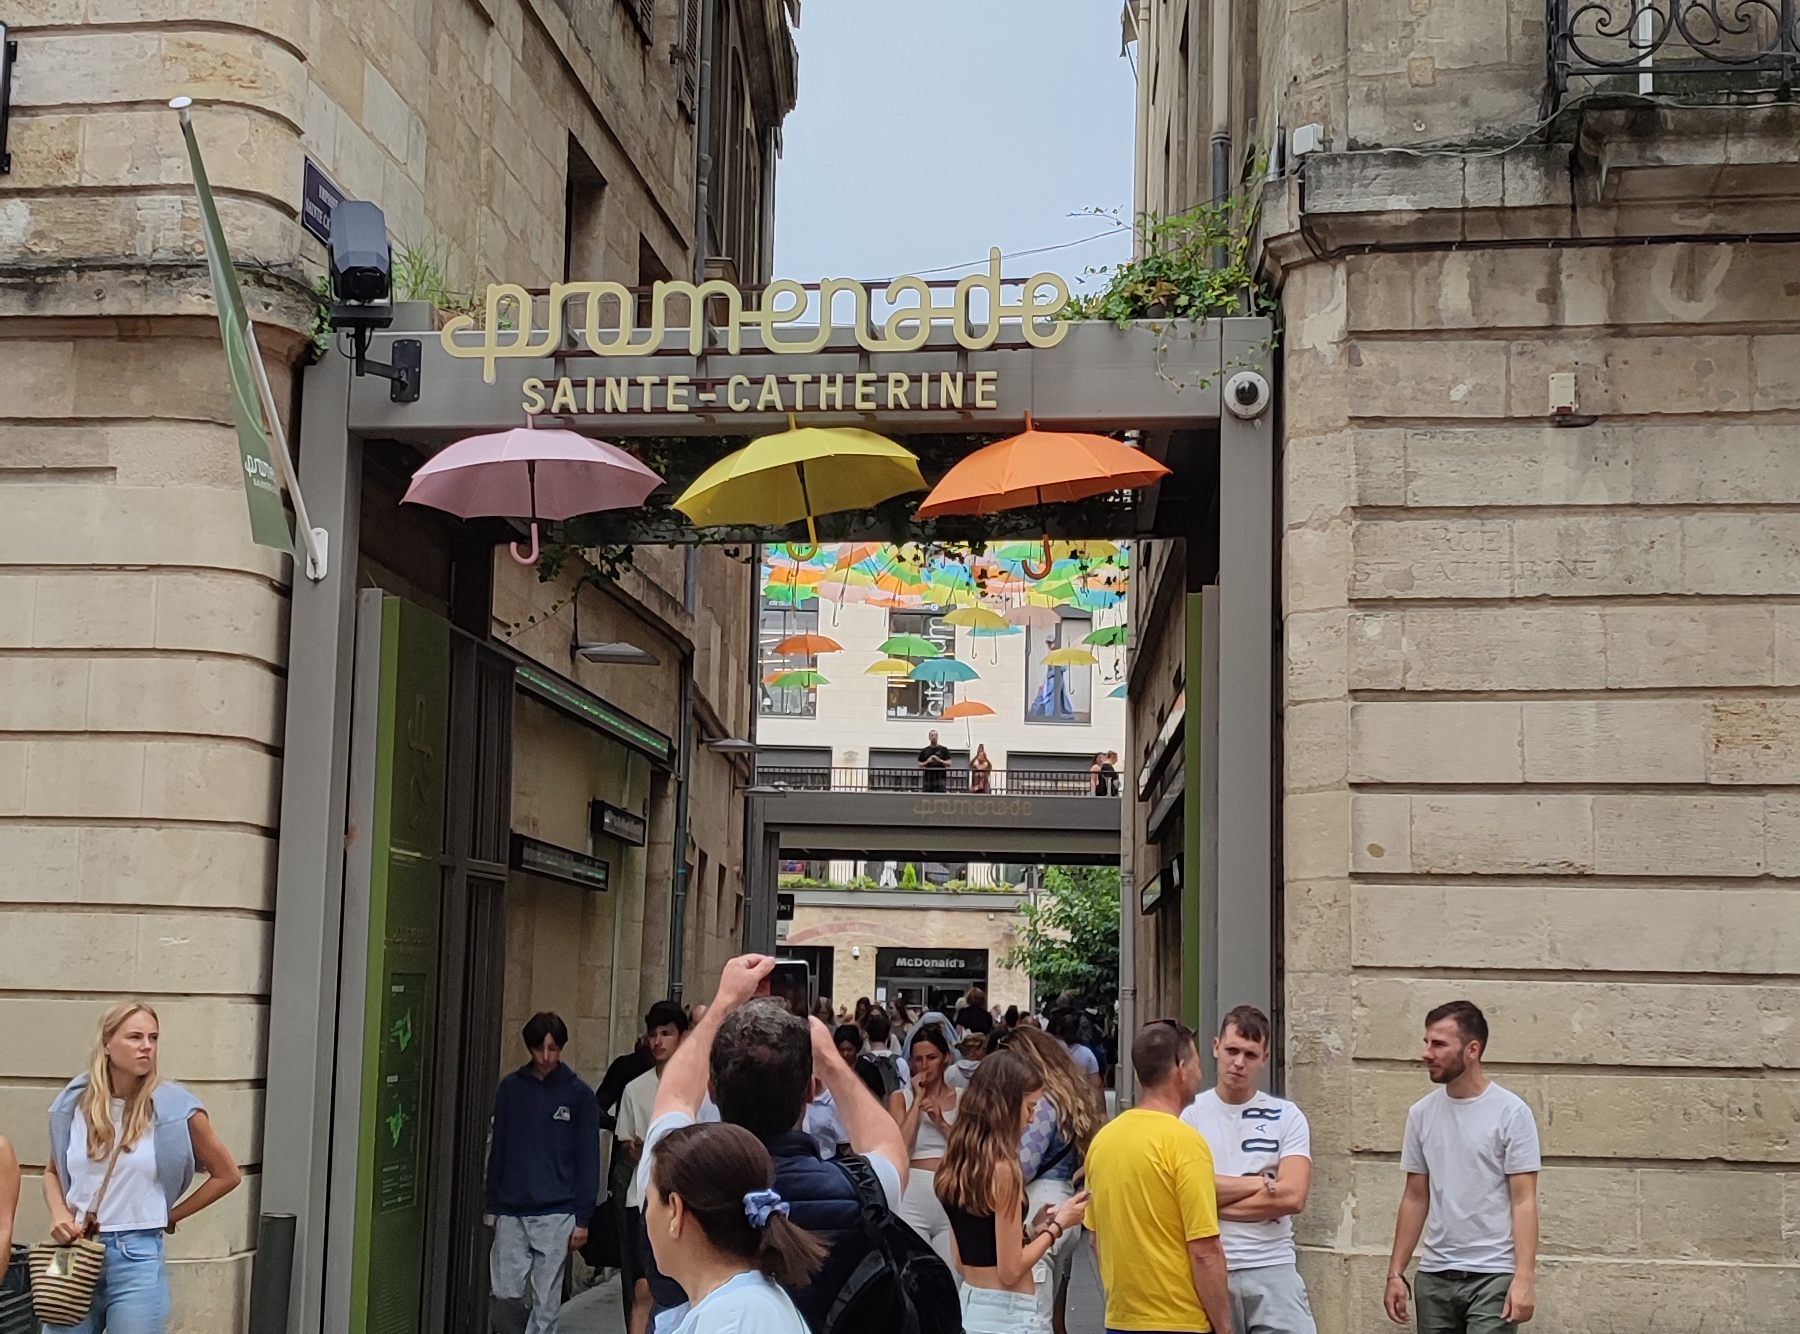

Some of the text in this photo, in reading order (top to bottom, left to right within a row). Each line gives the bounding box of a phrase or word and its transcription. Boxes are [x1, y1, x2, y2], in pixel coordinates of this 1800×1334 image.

[440, 246, 1070, 384] promenade
[521, 370, 999, 415] SAINTE-CATHERINE
[1430, 526, 1503, 552] RUE
[913, 798, 1033, 817] promenade
[896, 957, 966, 969] McDonald's
